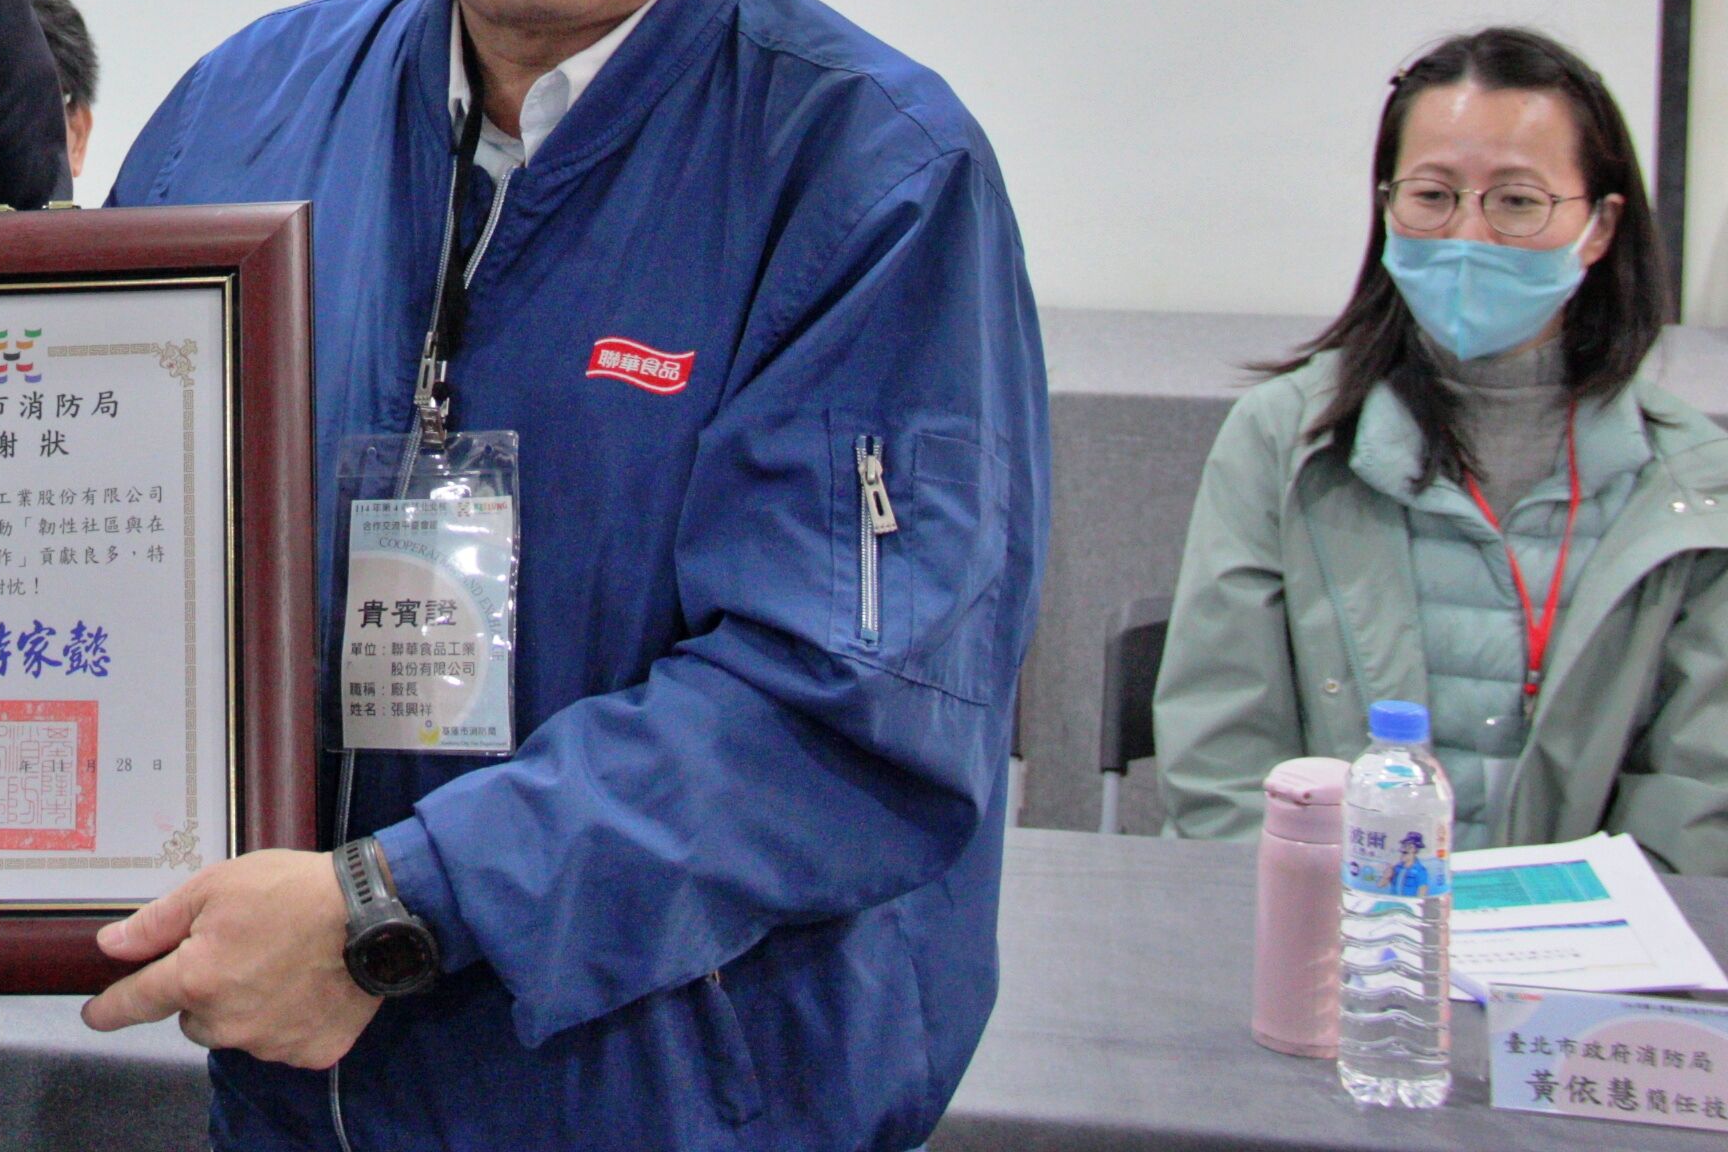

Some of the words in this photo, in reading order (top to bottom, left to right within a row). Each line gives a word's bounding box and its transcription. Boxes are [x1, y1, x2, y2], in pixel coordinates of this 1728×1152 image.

[597, 349, 680, 380] 聯華食品
[358, 598, 458, 628] 貴賓證
[391, 661, 476, 676] 股份有限公司
[116, 758, 133, 772] 28
[153, 759, 162, 771] 日
[1504, 1031, 1714, 1073] 臺北市政府消防局
